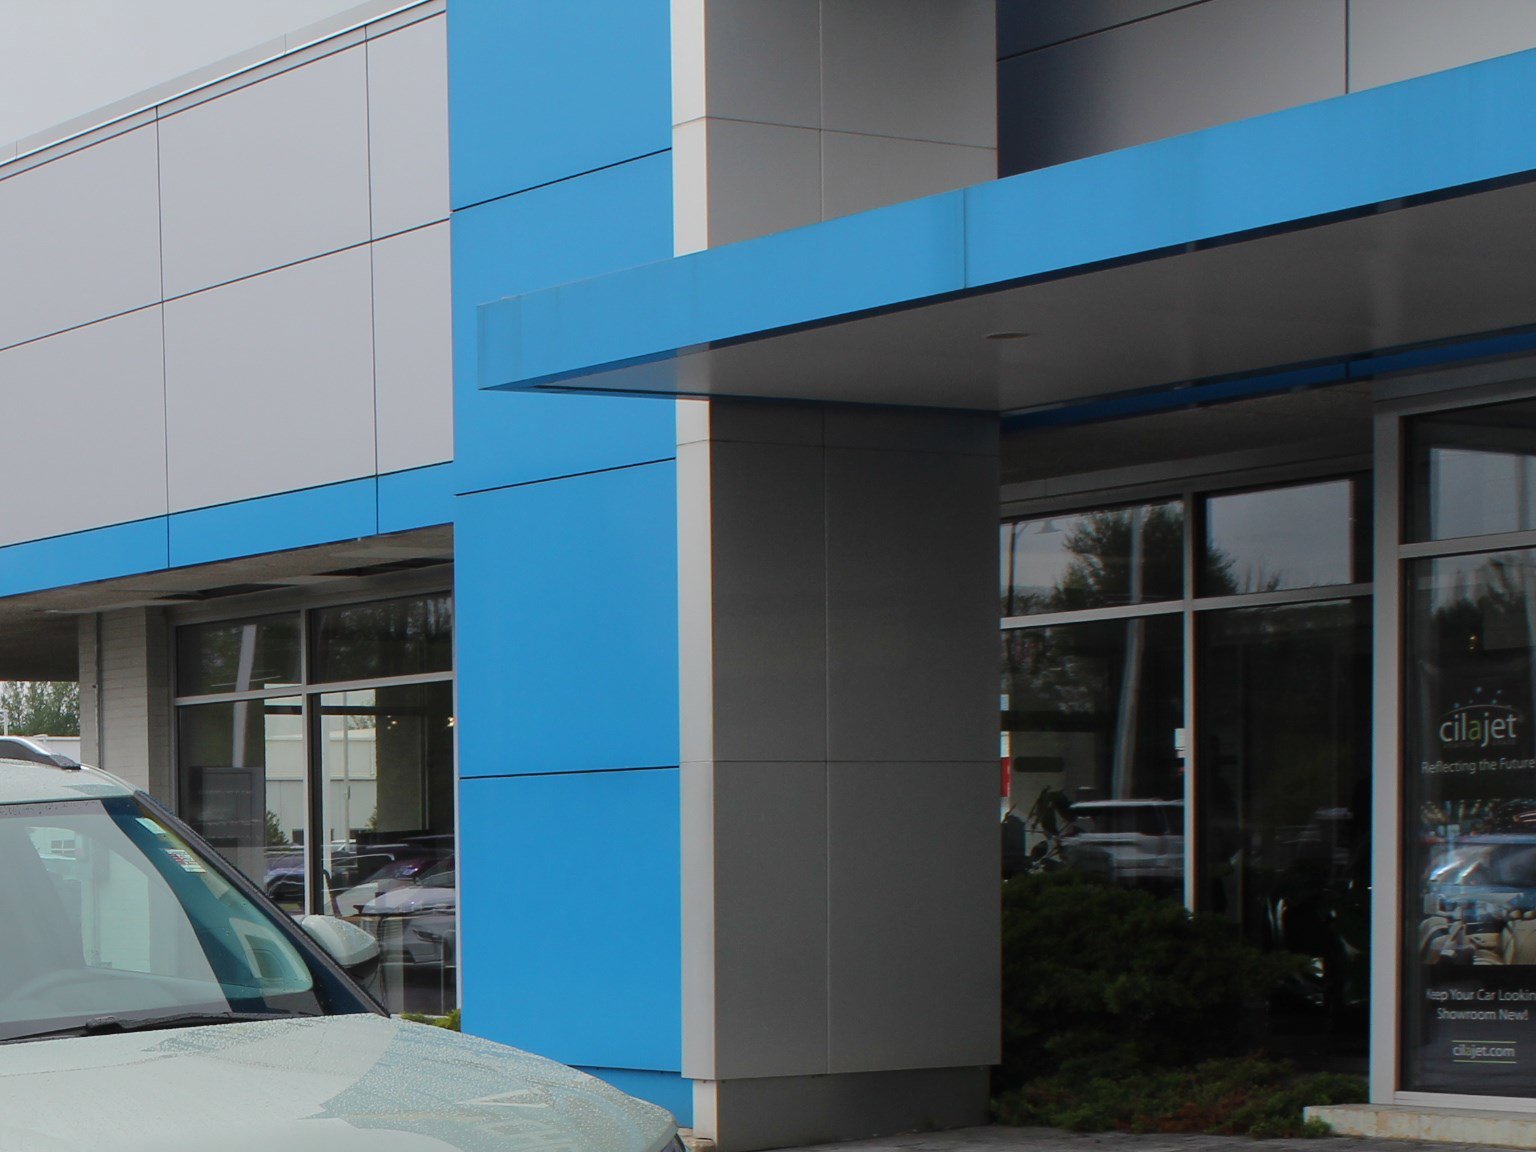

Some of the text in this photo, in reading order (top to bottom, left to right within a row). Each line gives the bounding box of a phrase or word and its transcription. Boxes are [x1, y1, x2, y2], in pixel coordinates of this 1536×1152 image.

[1439, 712, 1518, 748] cilajet
[1479, 759, 1497, 771] the
[1449, 988, 1475, 1000] Your
[1476, 988, 1496, 1000] Car
[1437, 1007, 1496, 1020] Showroom
[1452, 1043, 1516, 1059] cilajet.com
